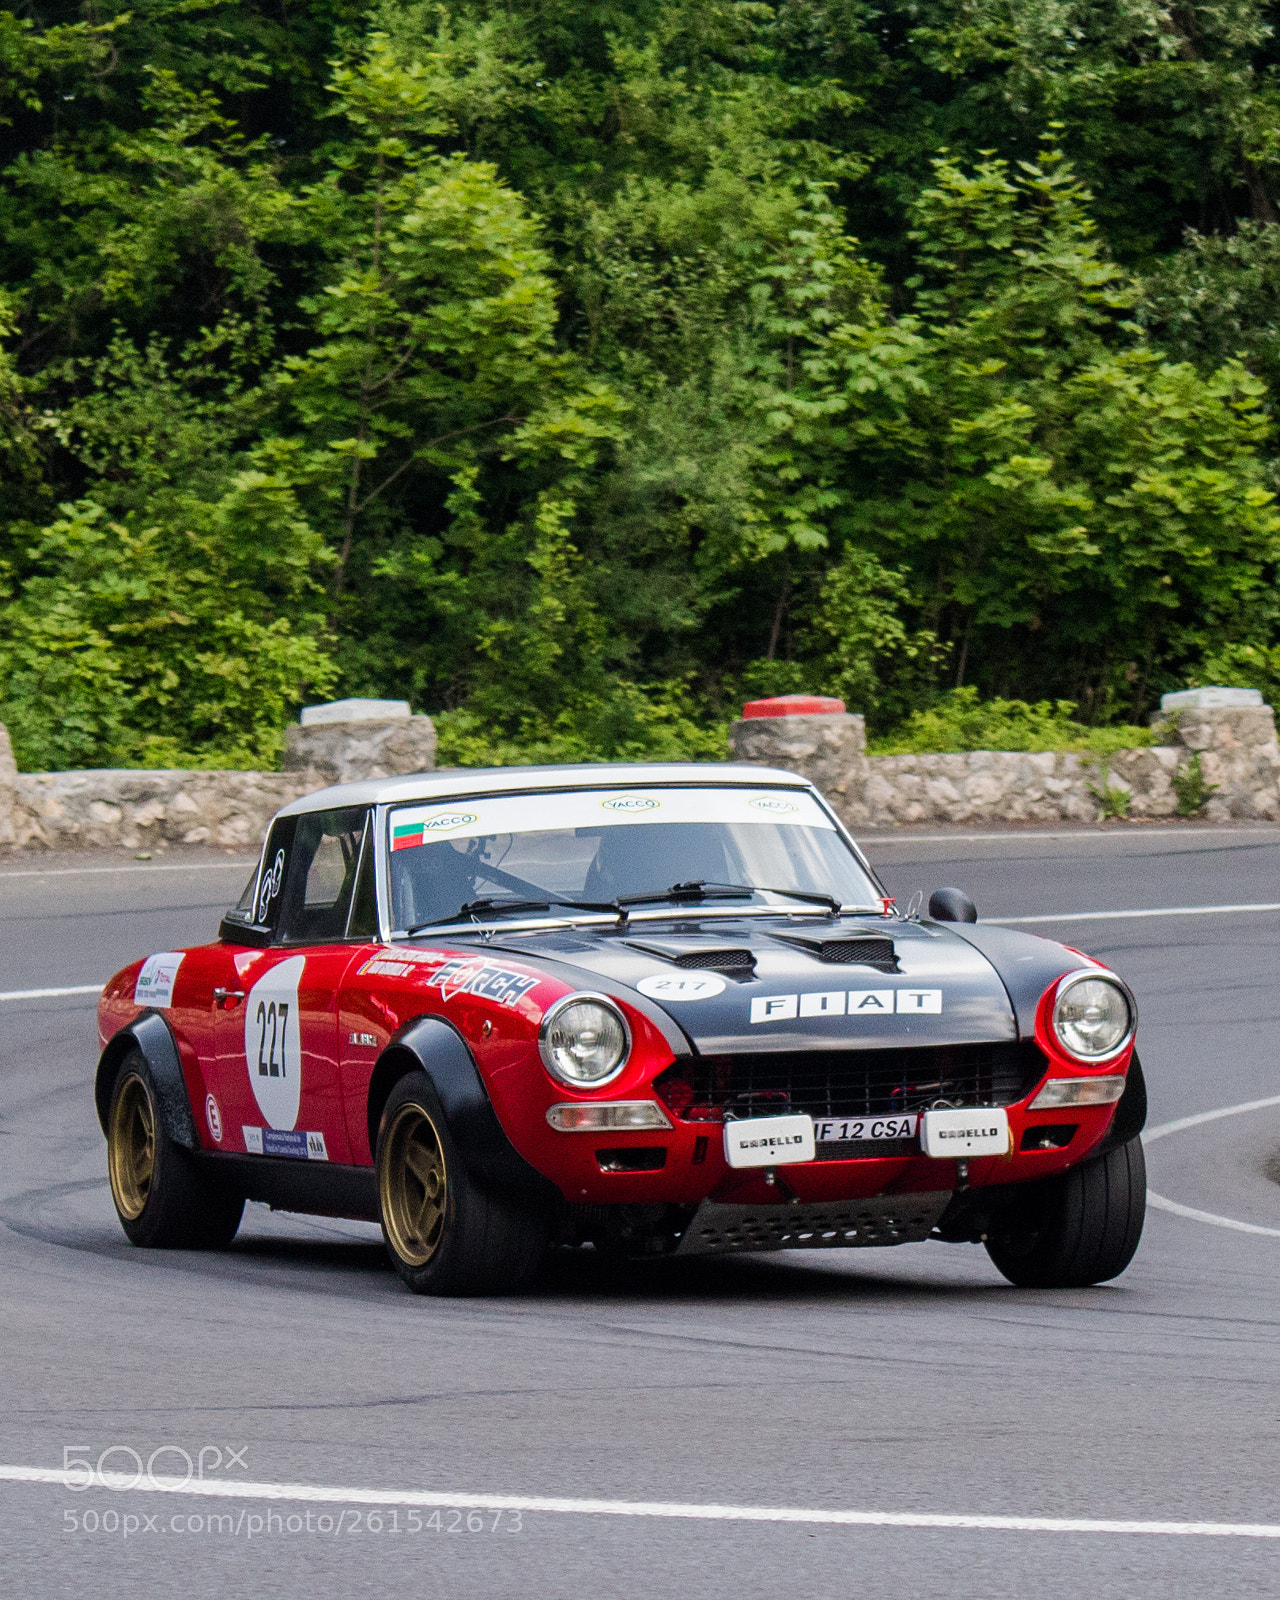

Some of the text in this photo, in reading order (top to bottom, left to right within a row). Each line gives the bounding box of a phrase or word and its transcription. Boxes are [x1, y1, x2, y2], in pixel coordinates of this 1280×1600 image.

[654, 980, 706, 991] 217
[764, 993, 932, 1016] FIAT
[257, 1001, 289, 1078] 227
[839, 1121, 864, 1140] 12
[870, 1119, 912, 1139] CSA
